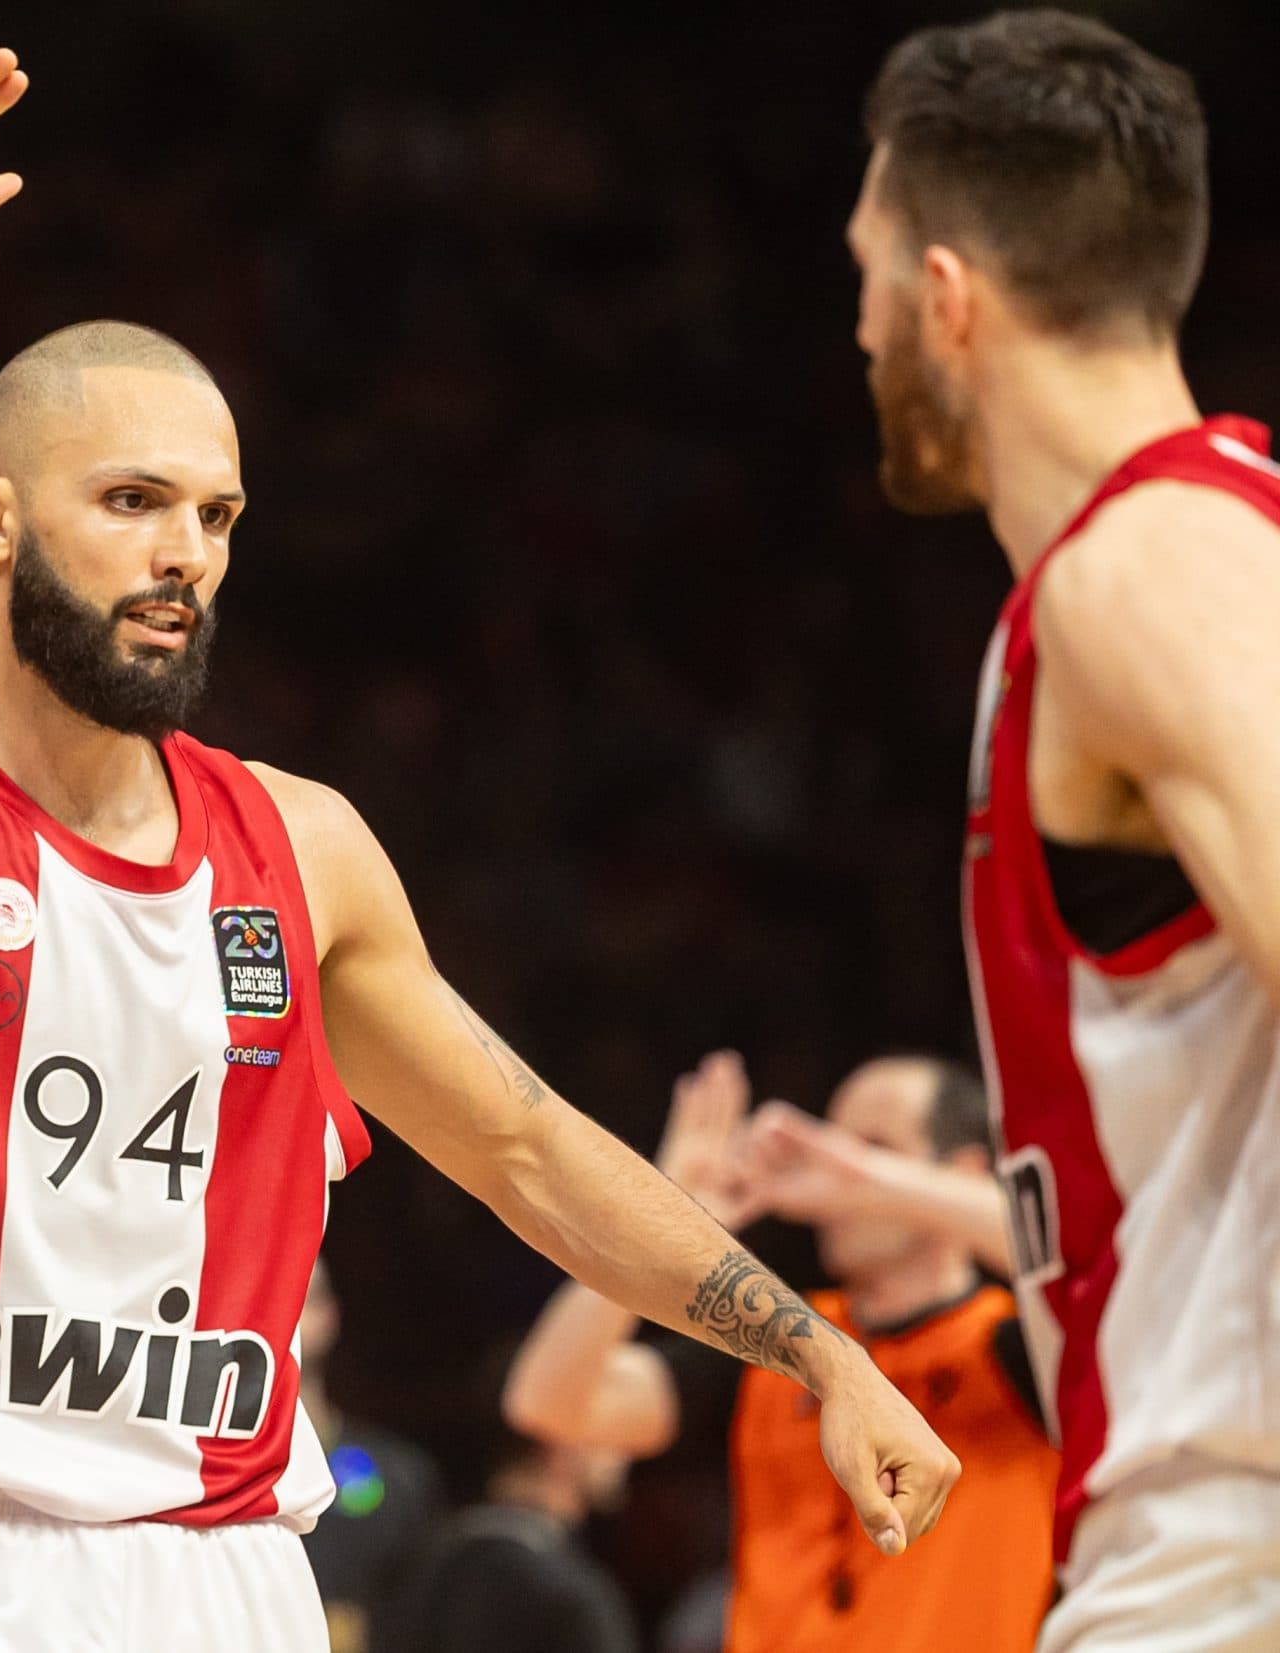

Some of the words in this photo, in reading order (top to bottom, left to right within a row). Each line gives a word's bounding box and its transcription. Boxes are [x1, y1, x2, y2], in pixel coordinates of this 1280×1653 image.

[220, 915, 279, 959] 25
[228, 966, 282, 981] TURKISH
[230, 979, 283, 994] AIRLINES
[23, 1055, 204, 1202] 94
